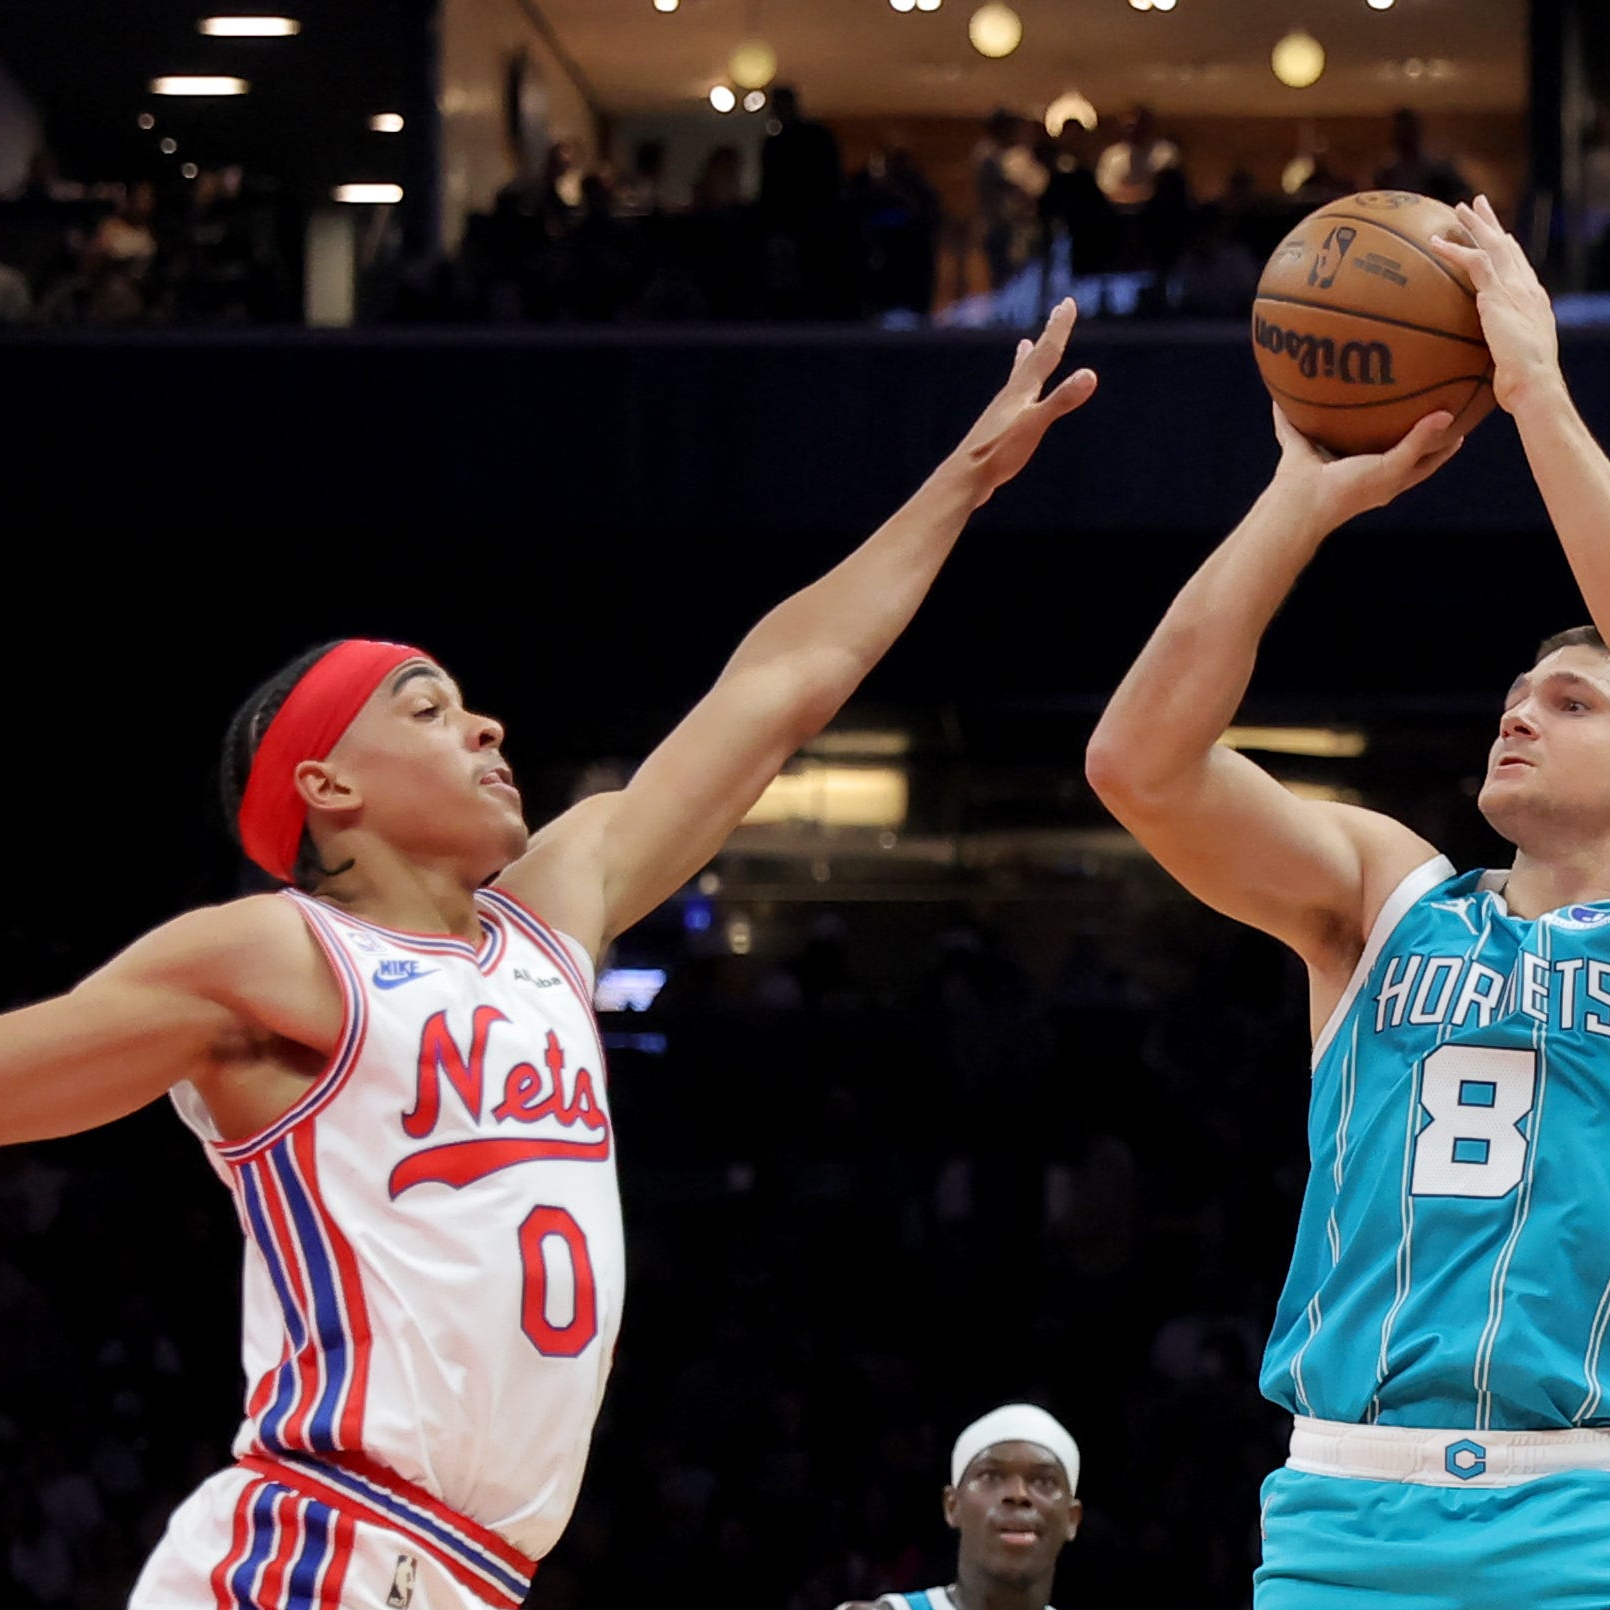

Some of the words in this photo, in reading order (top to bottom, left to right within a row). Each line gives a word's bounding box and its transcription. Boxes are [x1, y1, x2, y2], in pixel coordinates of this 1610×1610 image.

[1254, 312, 1396, 385] Wilson
[377, 959, 420, 977] NIKE
[400, 1003, 610, 1141] Nets
[1409, 1042, 1542, 1200] 8
[517, 1203, 598, 1359] 0
